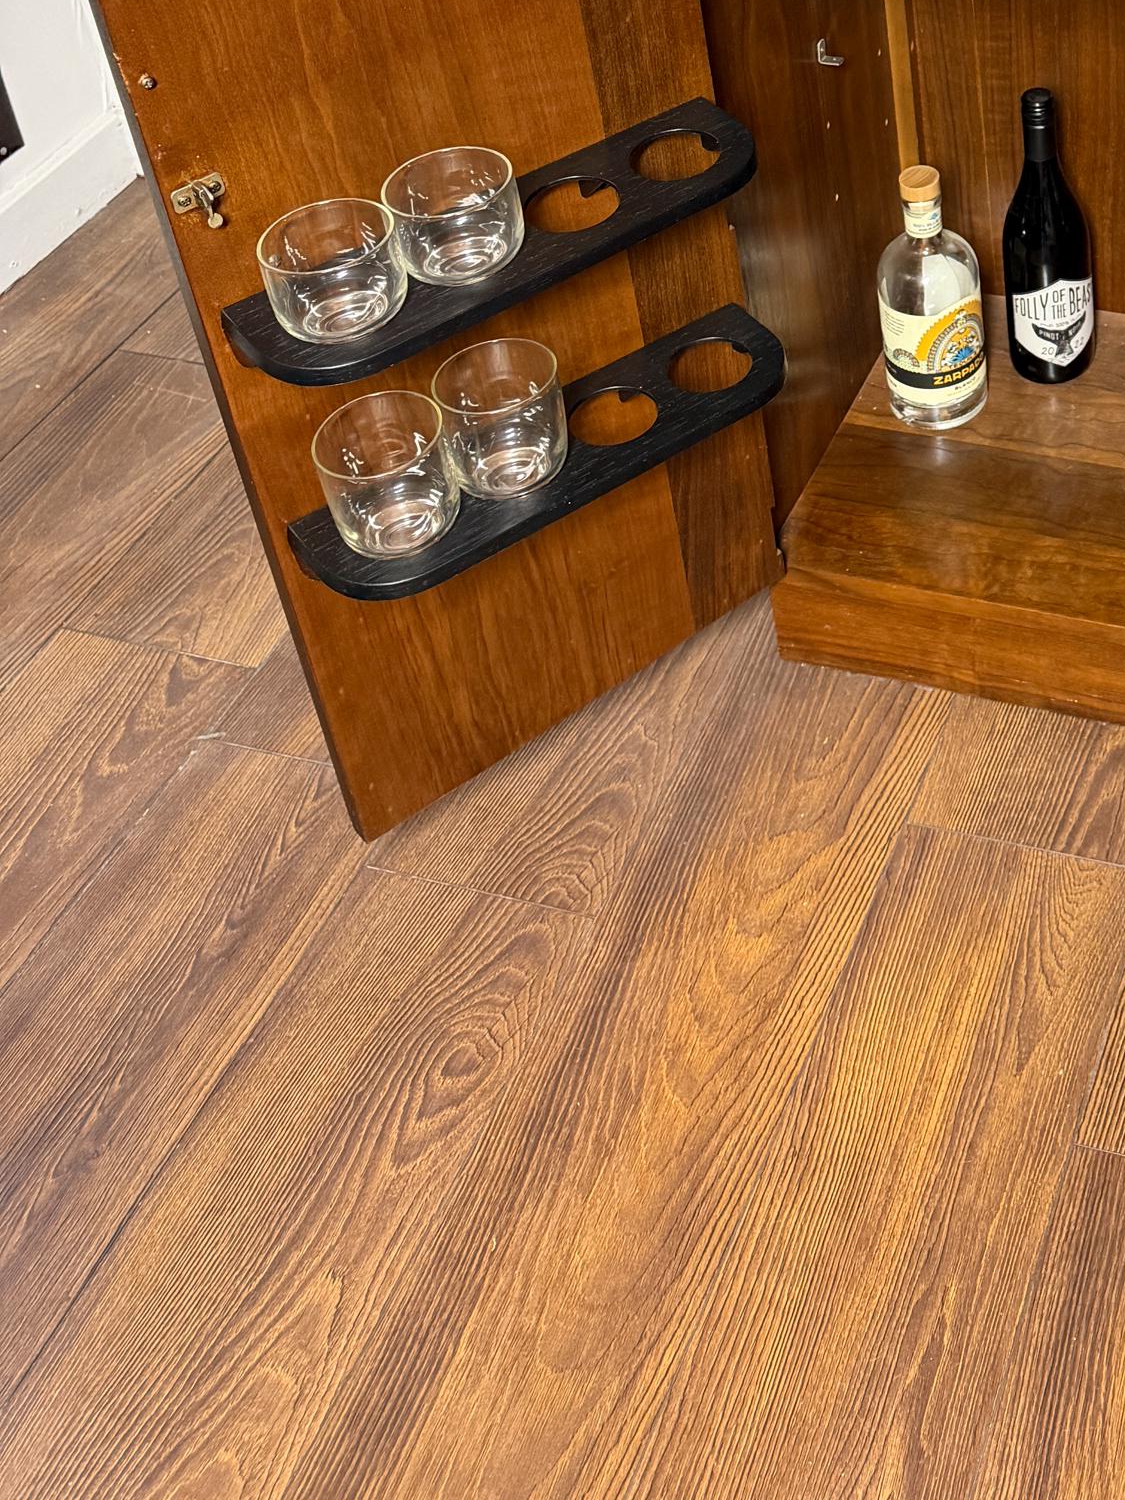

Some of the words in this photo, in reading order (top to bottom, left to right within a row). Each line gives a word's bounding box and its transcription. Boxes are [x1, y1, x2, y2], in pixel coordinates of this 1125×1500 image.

[1052, 288, 1066, 303] OF
[1068, 282, 1092, 315] BEAS
[1015, 293, 1049, 320] FOLLY
[1051, 303, 1067, 319] THE
[1038, 329, 1059, 341] PINOT
[1042, 347, 1056, 356] 20
